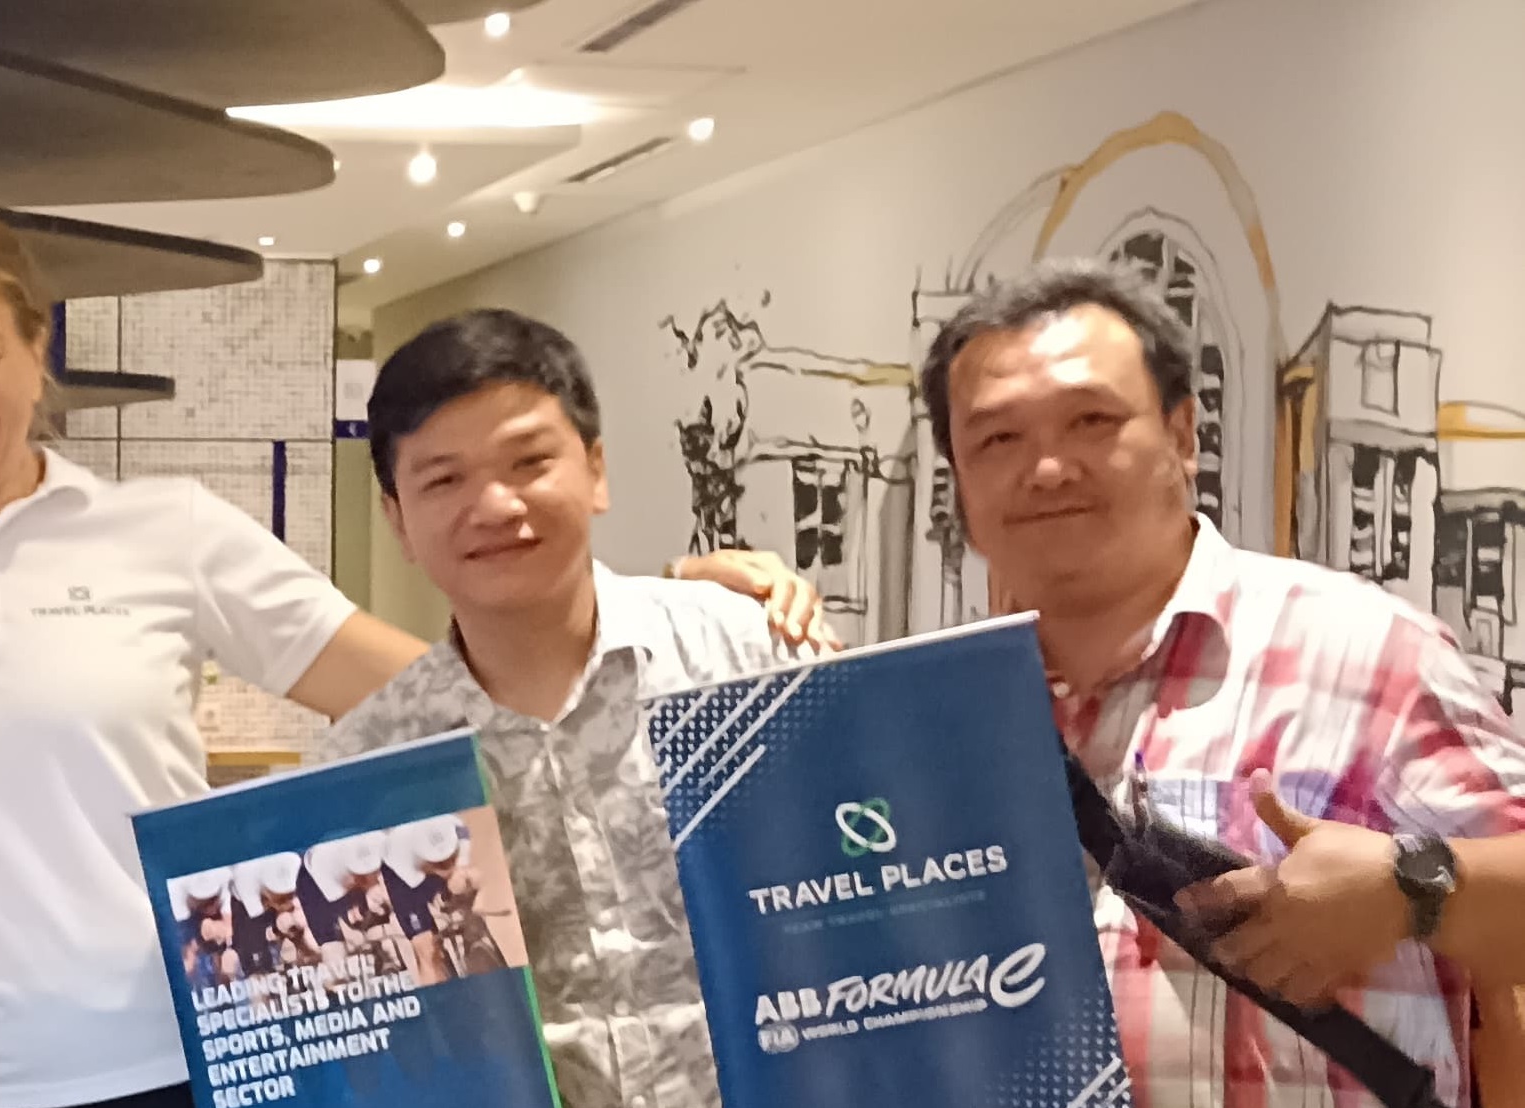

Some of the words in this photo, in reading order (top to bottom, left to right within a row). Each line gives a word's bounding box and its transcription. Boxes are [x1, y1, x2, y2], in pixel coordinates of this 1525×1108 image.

[748, 871, 875, 915] TRAVEL
[881, 845, 1008, 892] PLACES
[190, 972, 288, 1012] LEADING
[334, 983, 361, 1006] TO
[755, 988, 823, 1026] ABB
[825, 954, 989, 1018] FORMULA
[202, 1023, 292, 1062] SPORTS,
[295, 1006, 368, 1043] MEDIA
[373, 995, 422, 1025] AND
[207, 1027, 391, 1087] ENTERTAINMENT
